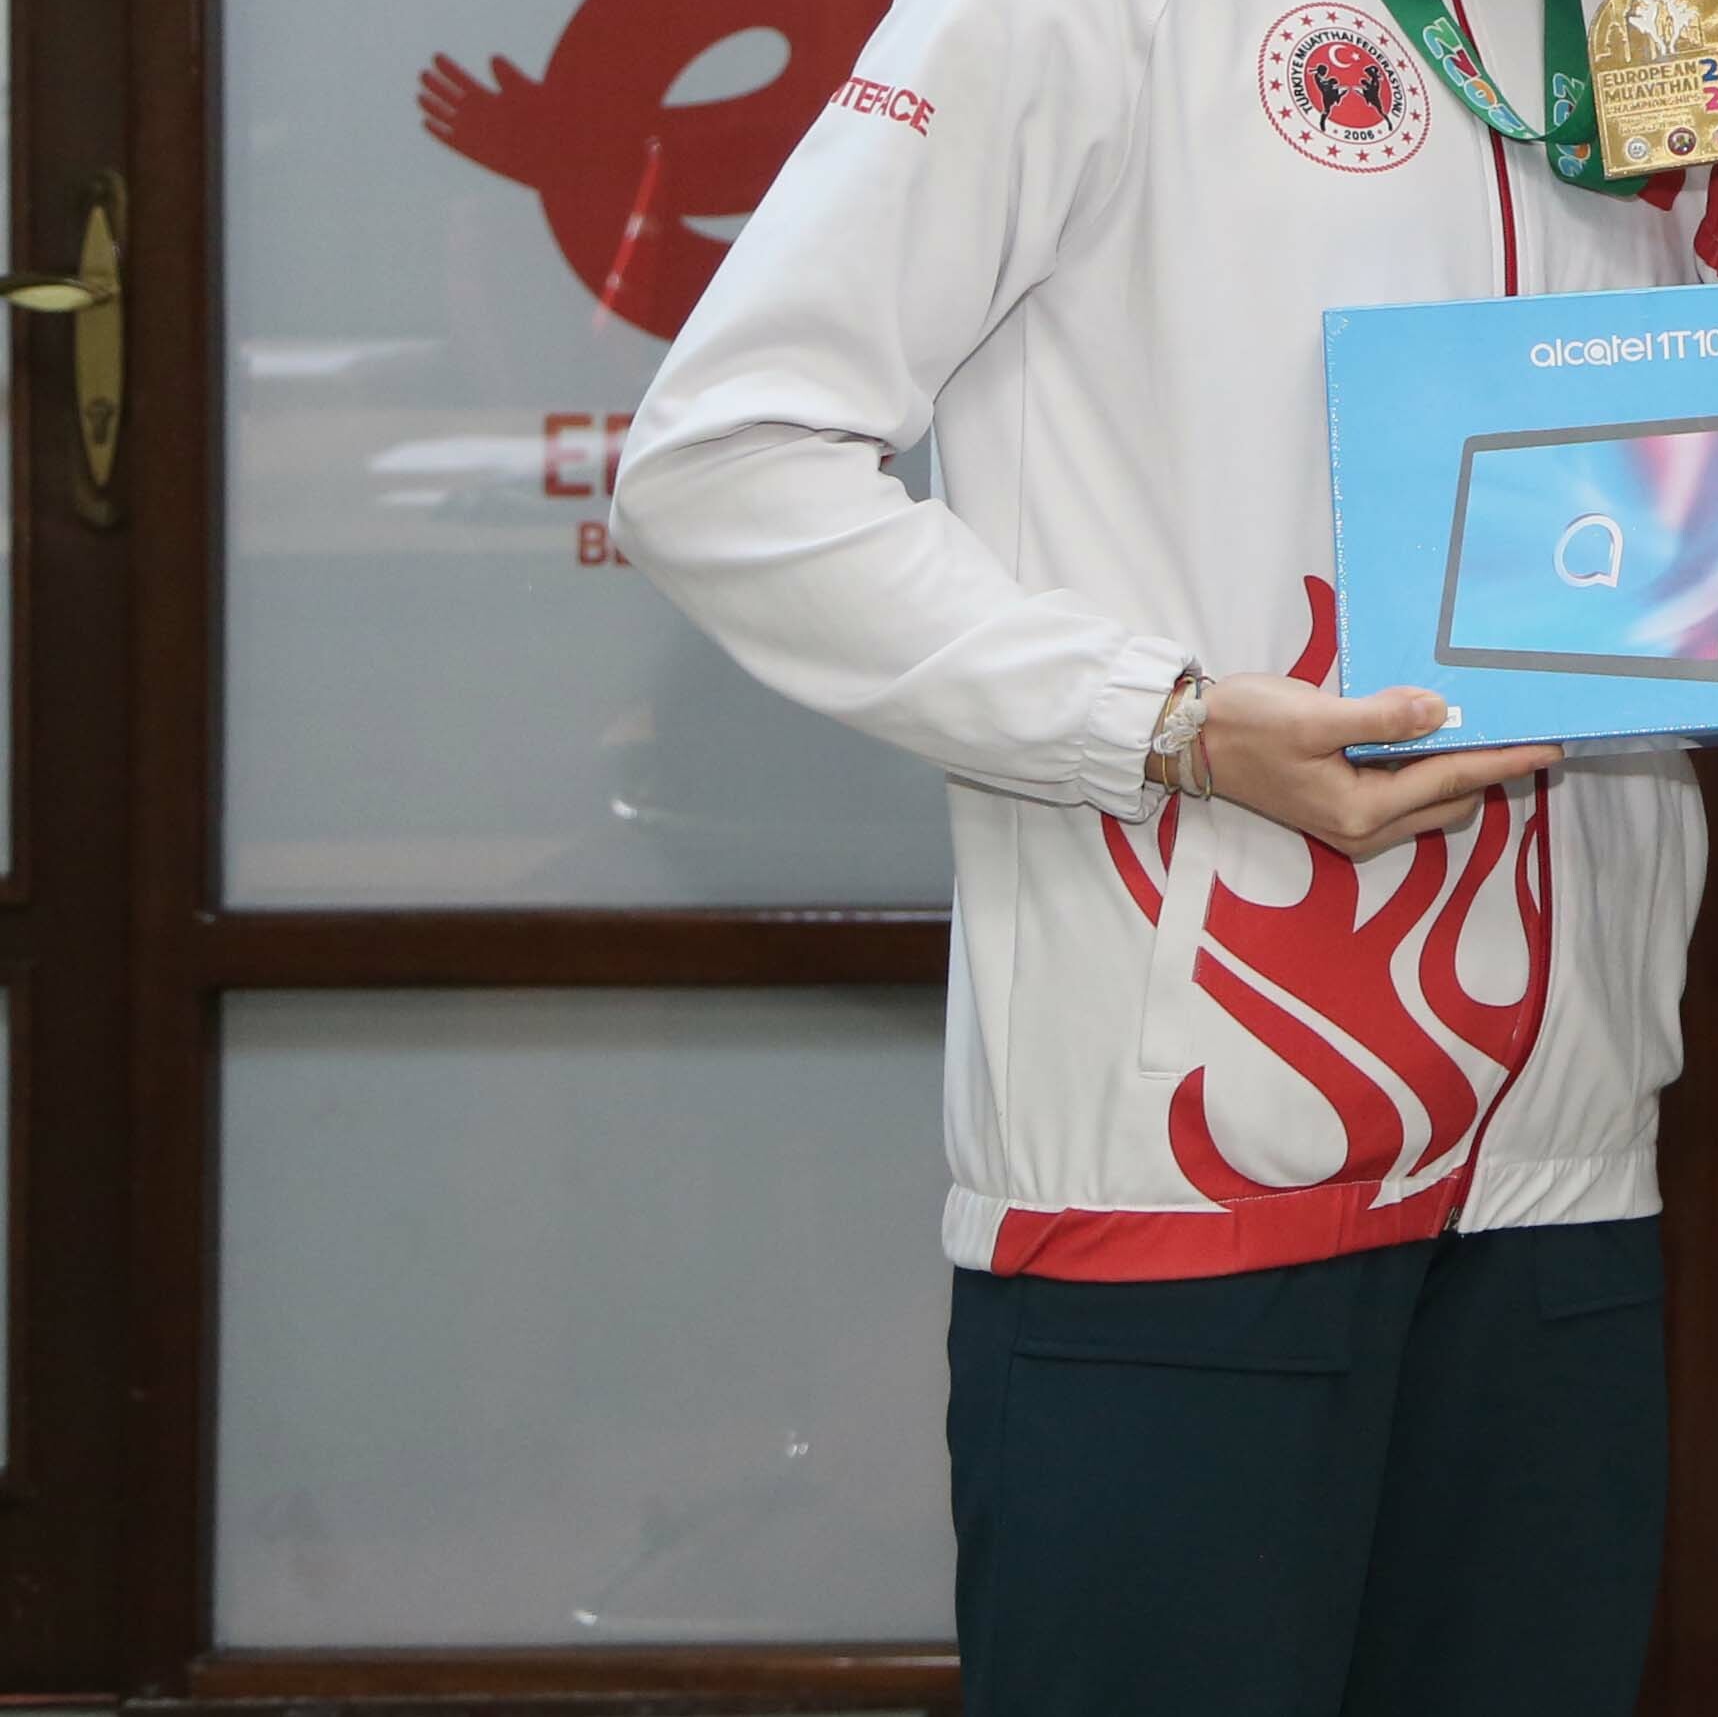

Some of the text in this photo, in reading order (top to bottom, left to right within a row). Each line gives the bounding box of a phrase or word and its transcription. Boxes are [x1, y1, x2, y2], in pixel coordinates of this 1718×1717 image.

[1294, 30, 1355, 62] MUAYTHAI
[1355, 38, 1404, 119] FEDERASYONU
[1602, 61, 1697, 89] EUROPEAN
[1603, 76, 1699, 103] MUAYTHAI
[1343, 130, 1376, 142] 2006
[1530, 333, 1653, 367] alcatel
